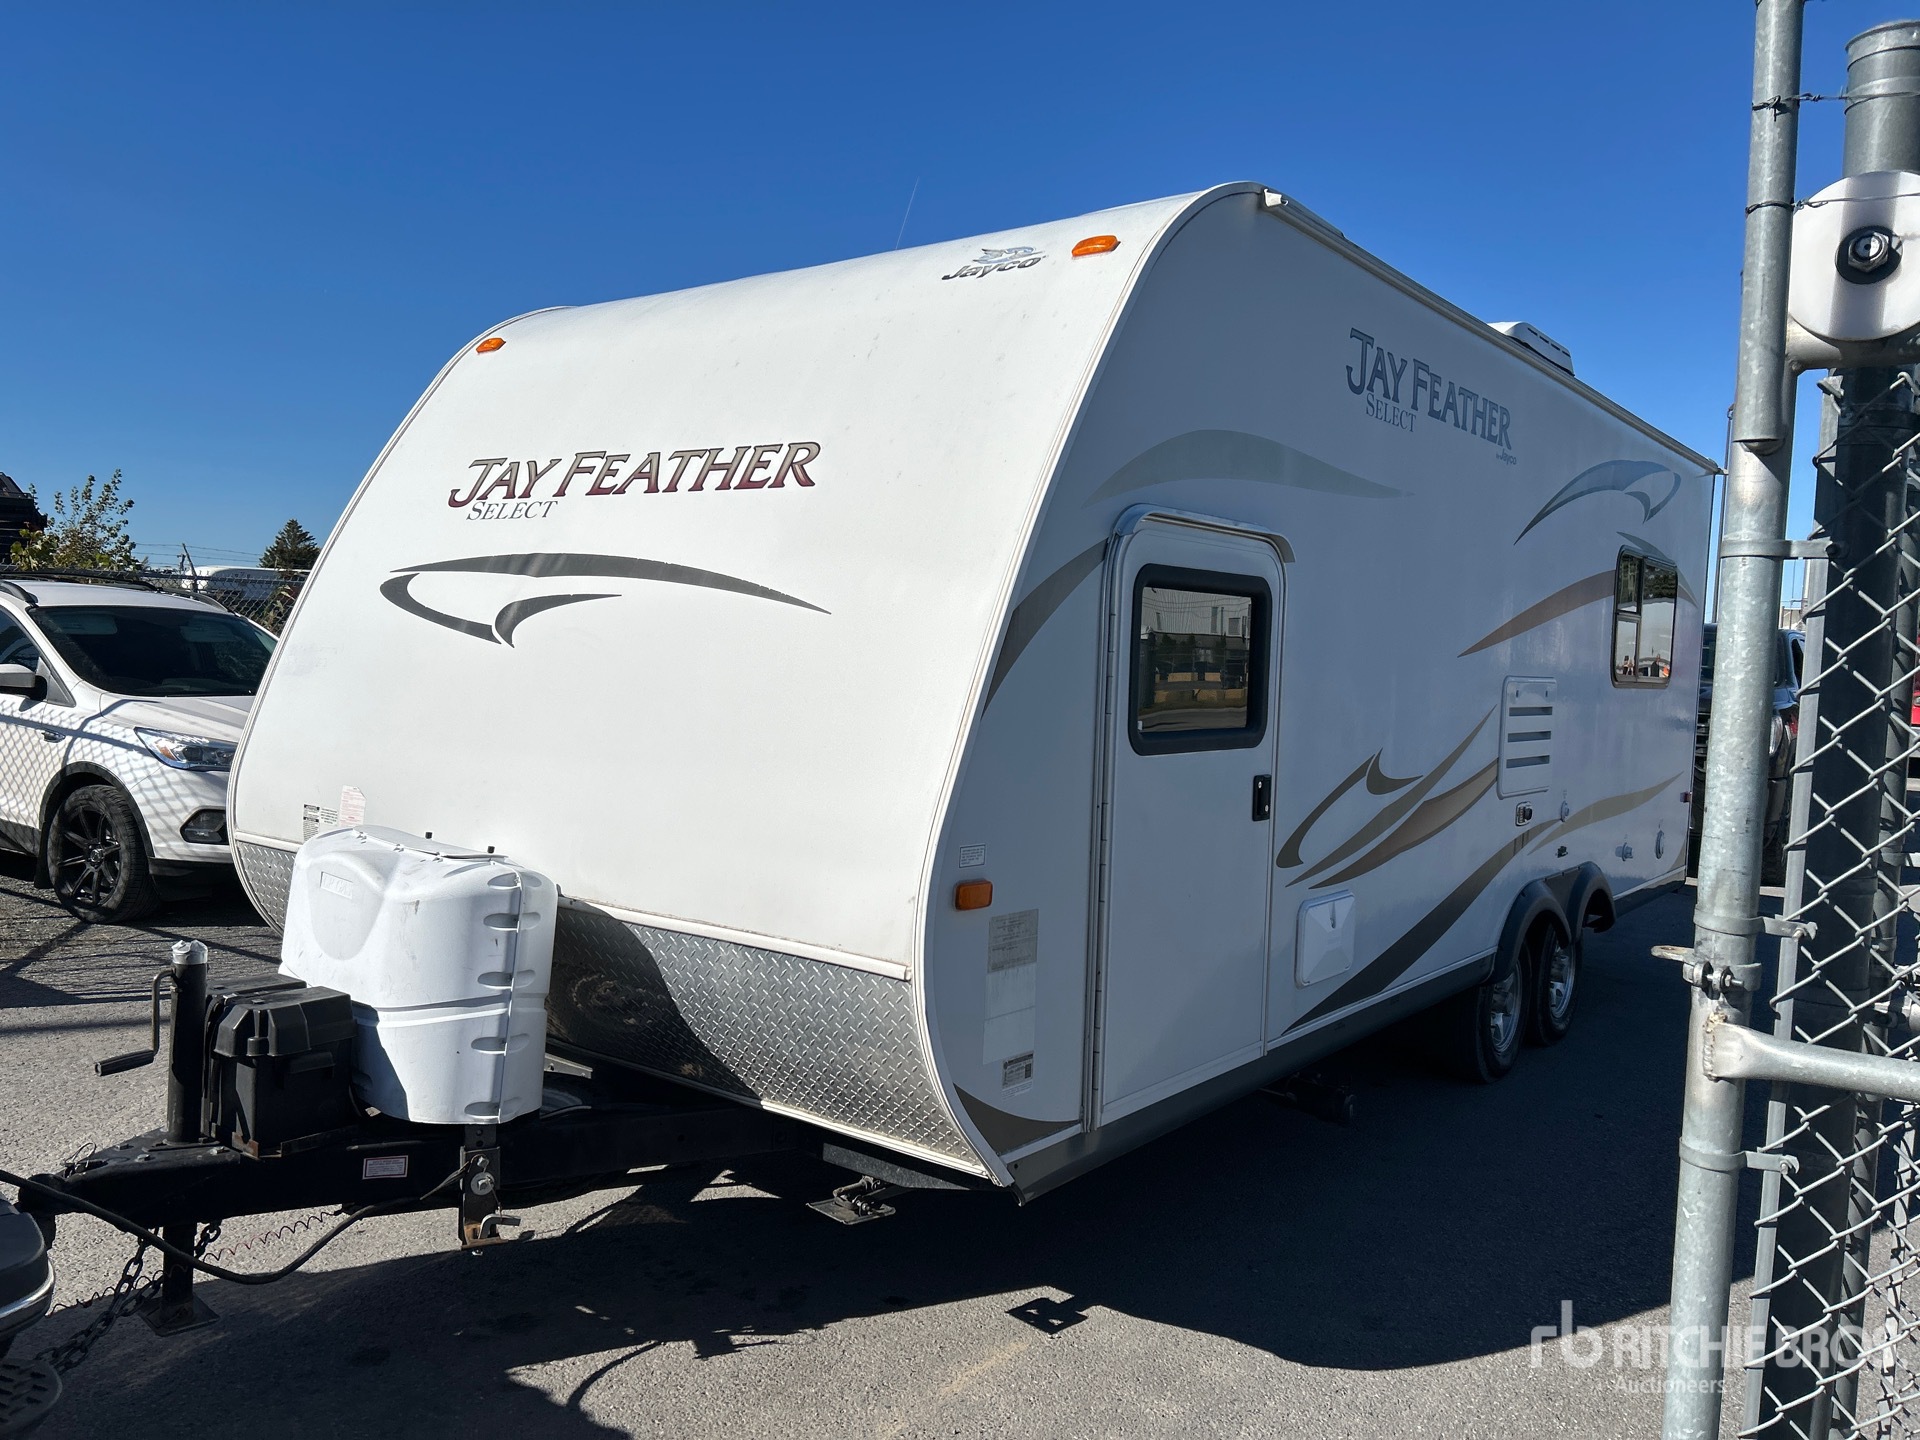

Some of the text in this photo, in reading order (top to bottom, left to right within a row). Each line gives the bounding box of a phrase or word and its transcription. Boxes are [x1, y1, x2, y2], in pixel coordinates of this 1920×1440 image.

[941, 257, 1041, 280] Jayco
[1346, 327, 1512, 450] JAY FEATHER
[1366, 392, 1416, 433] SELECT
[448, 441, 822, 508] JAY FEATHER
[466, 500, 558, 521] SELECT
